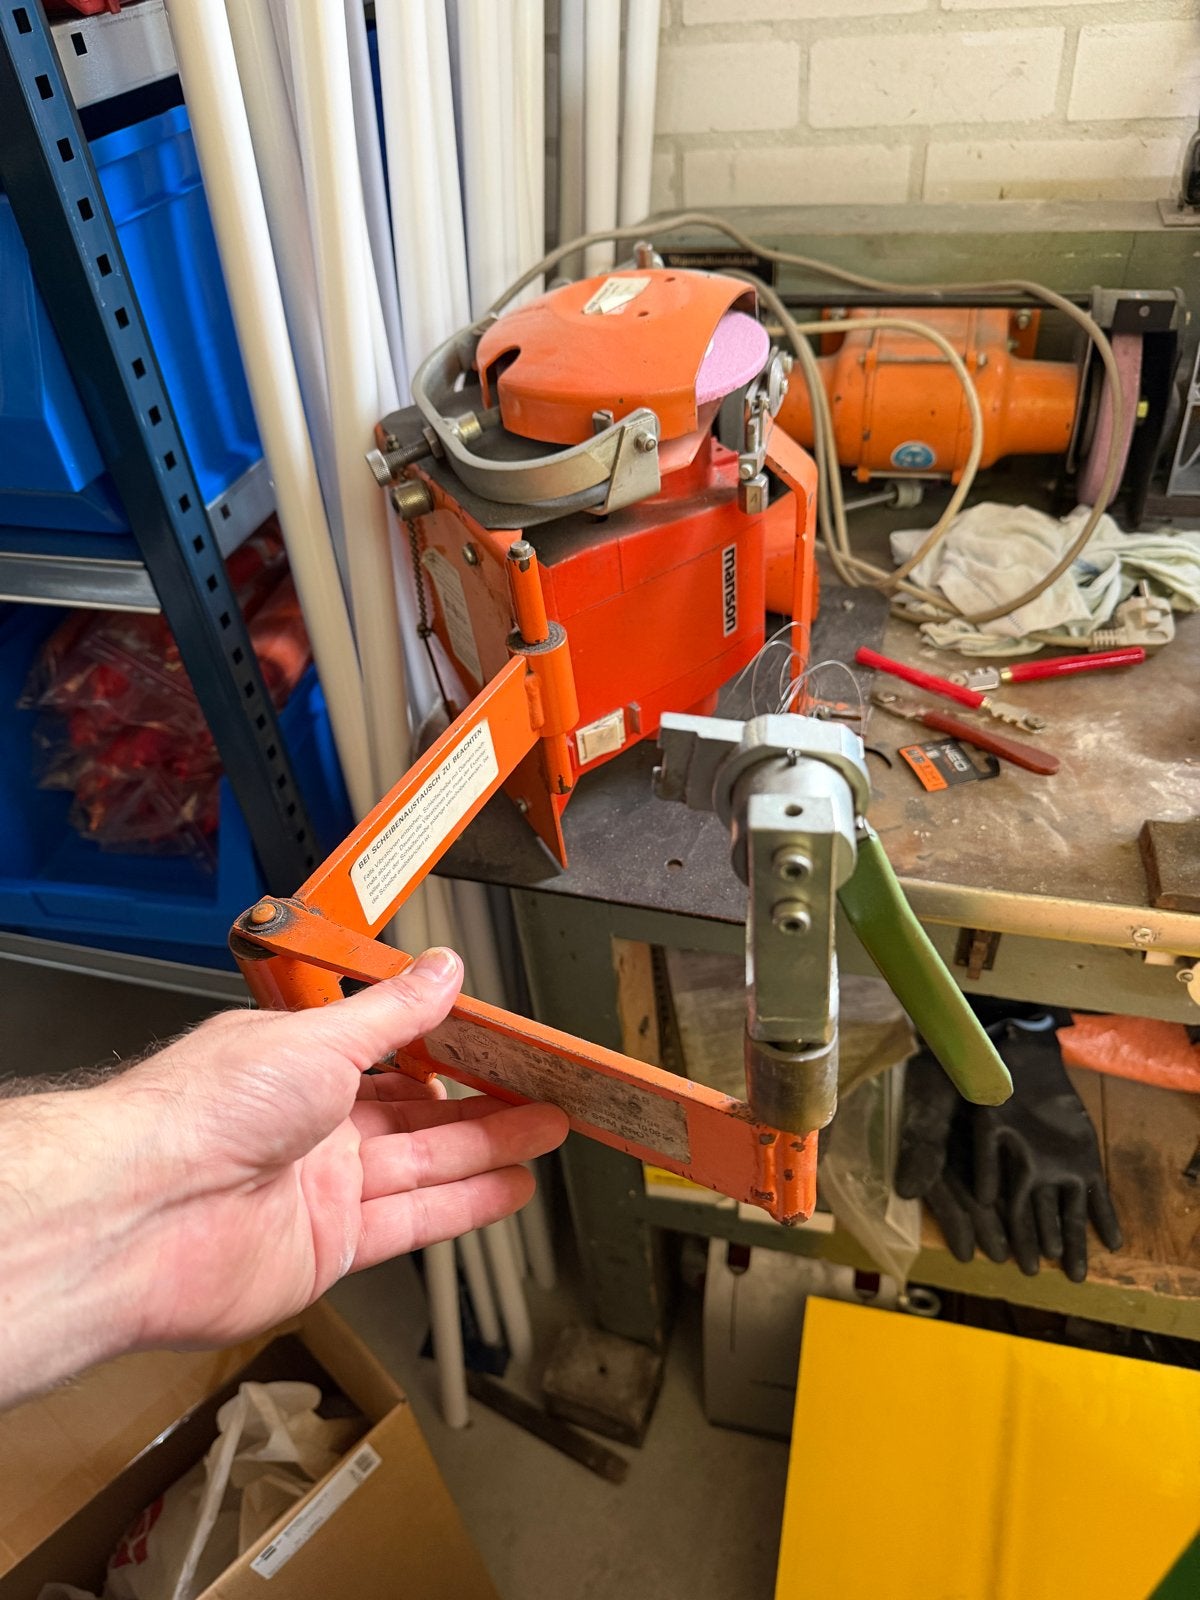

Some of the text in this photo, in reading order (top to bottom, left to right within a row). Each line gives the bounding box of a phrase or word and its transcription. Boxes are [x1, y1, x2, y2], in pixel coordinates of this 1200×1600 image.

[724, 547, 737, 633] manson
[940, 744, 969, 772] NEO
[358, 728, 483, 869] BEI SCHEIBENAUSTAUSCH ZU BEACHTEN
[375, 838, 401, 869] Vibrationen
[379, 873, 398, 896] Scheibe
